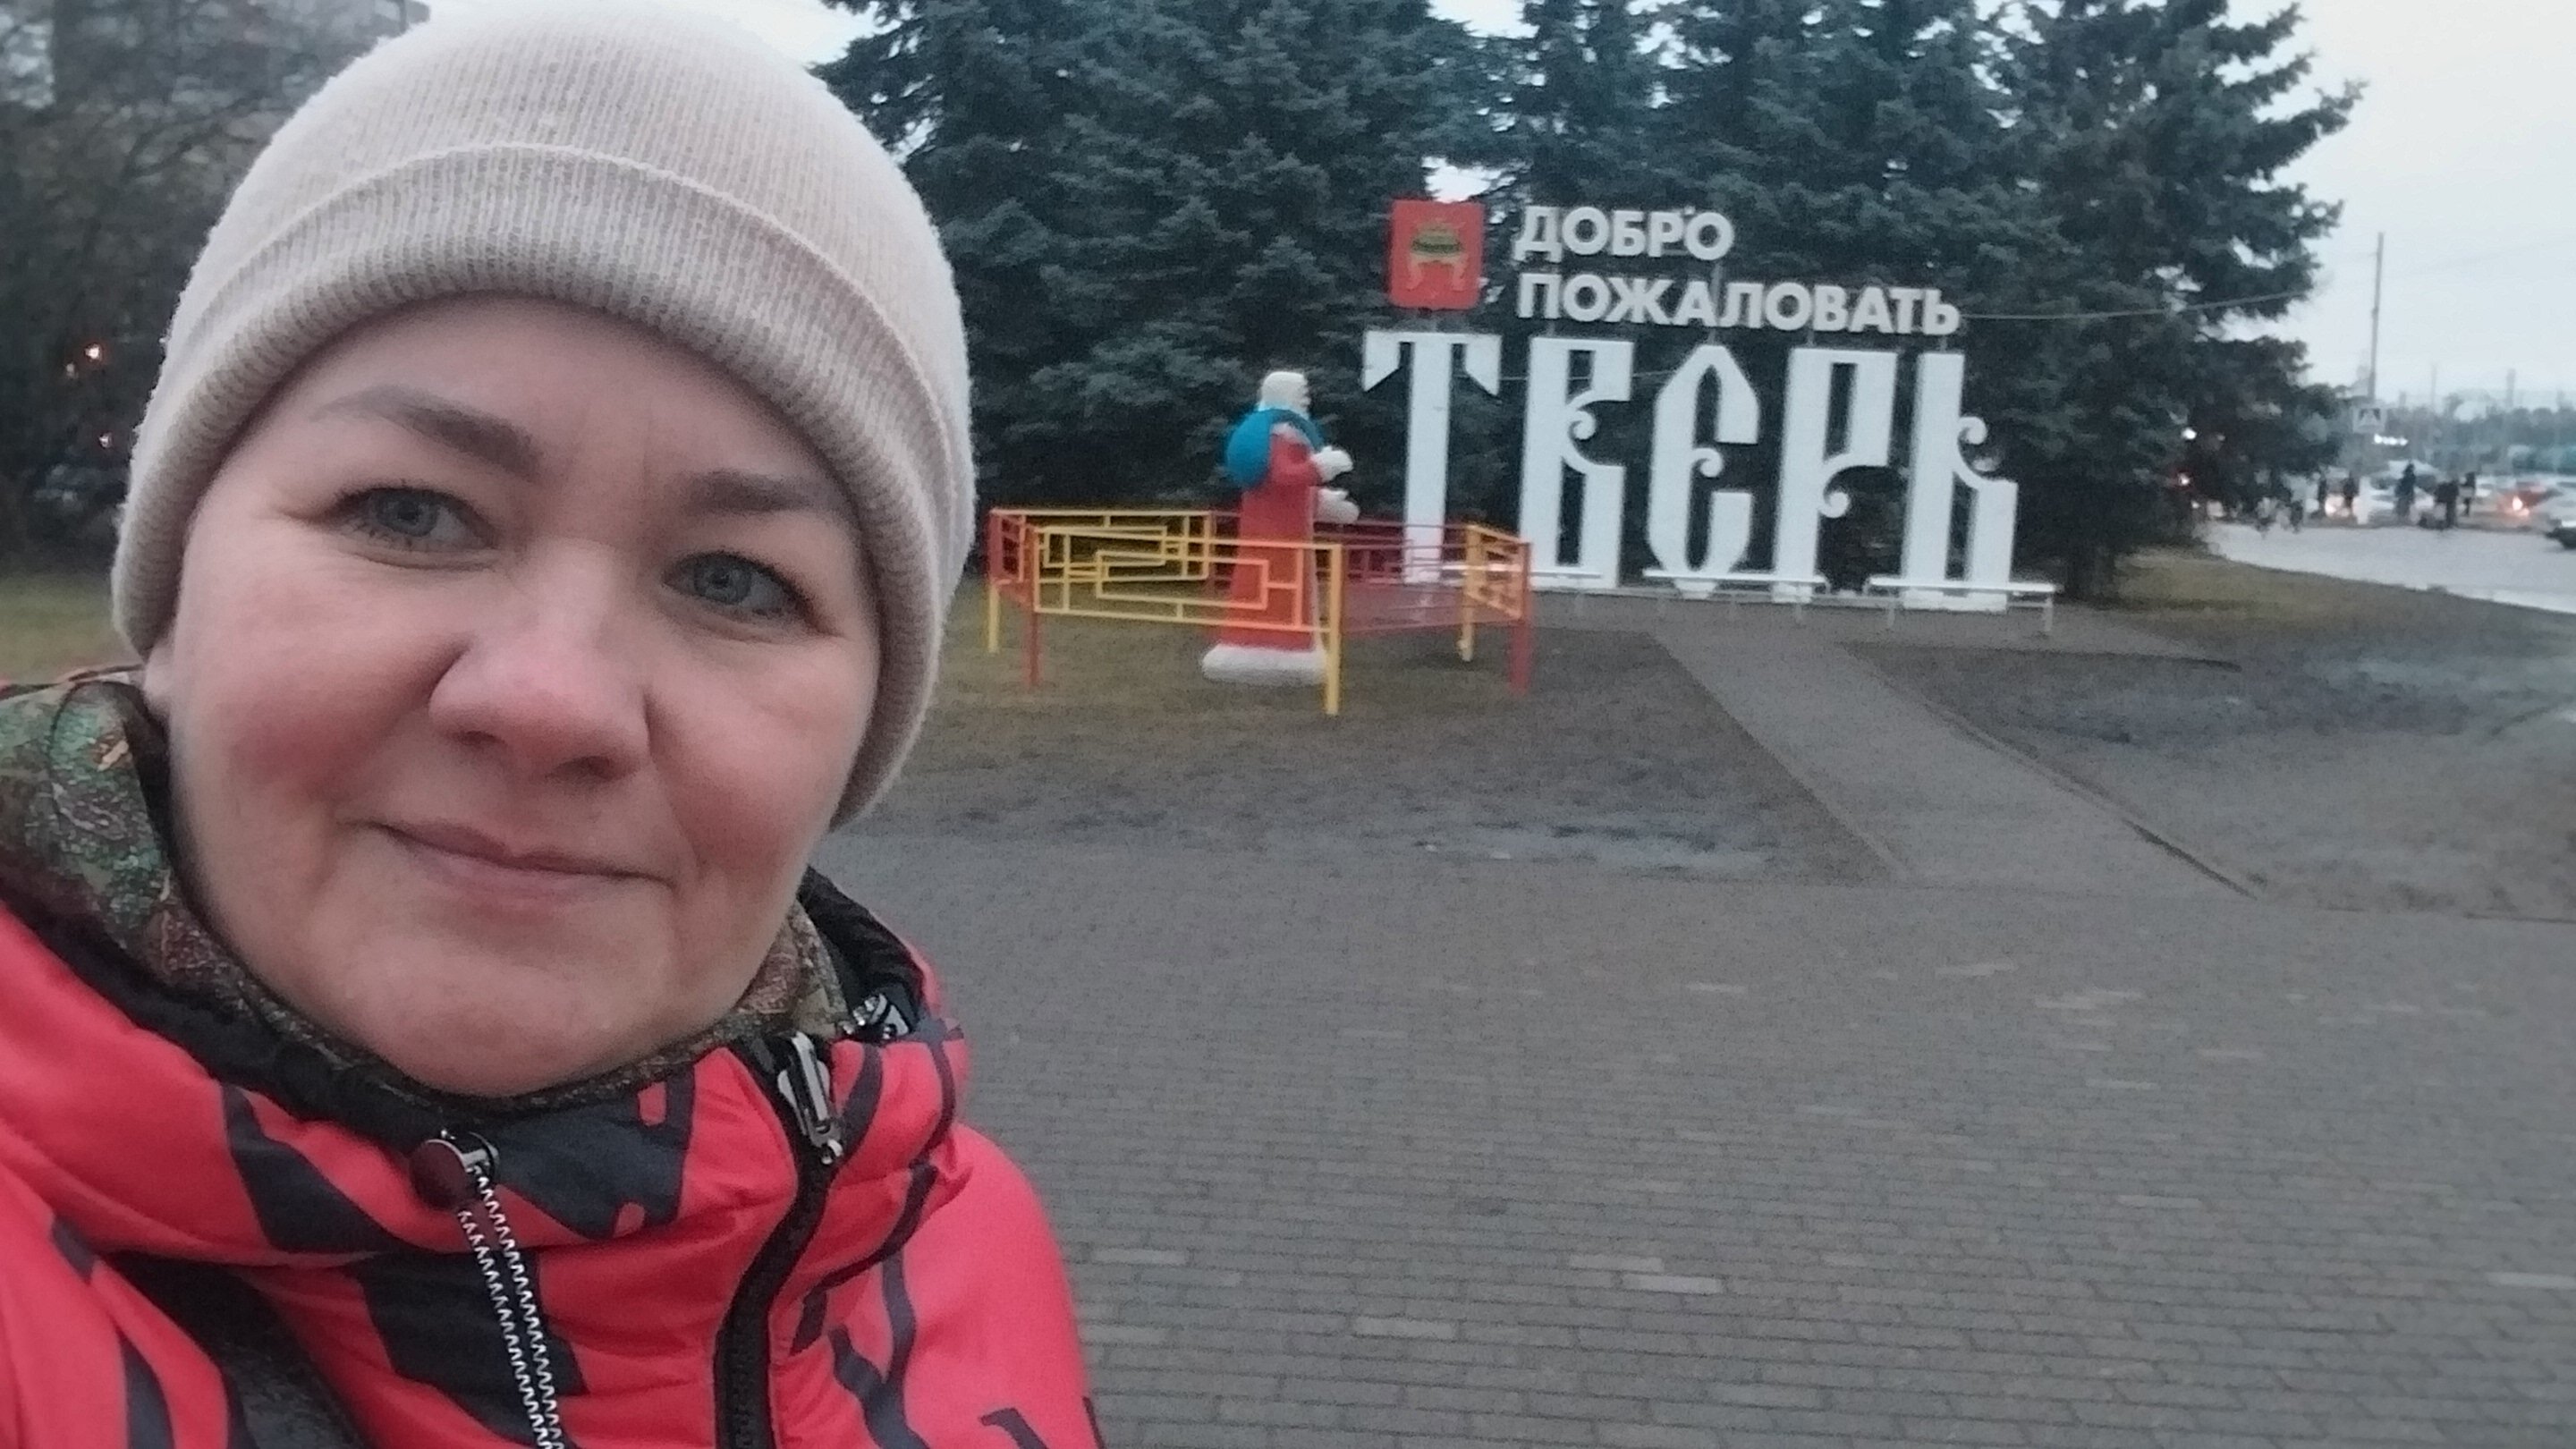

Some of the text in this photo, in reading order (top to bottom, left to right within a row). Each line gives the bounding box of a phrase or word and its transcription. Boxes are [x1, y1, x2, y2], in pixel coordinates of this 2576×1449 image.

[1513, 206, 1734, 262] ДОБРО
[1516, 273, 1962, 336] ПОЖАЛОВАТЬ
[1362, 330, 2018, 612] ТВЕРЬ
